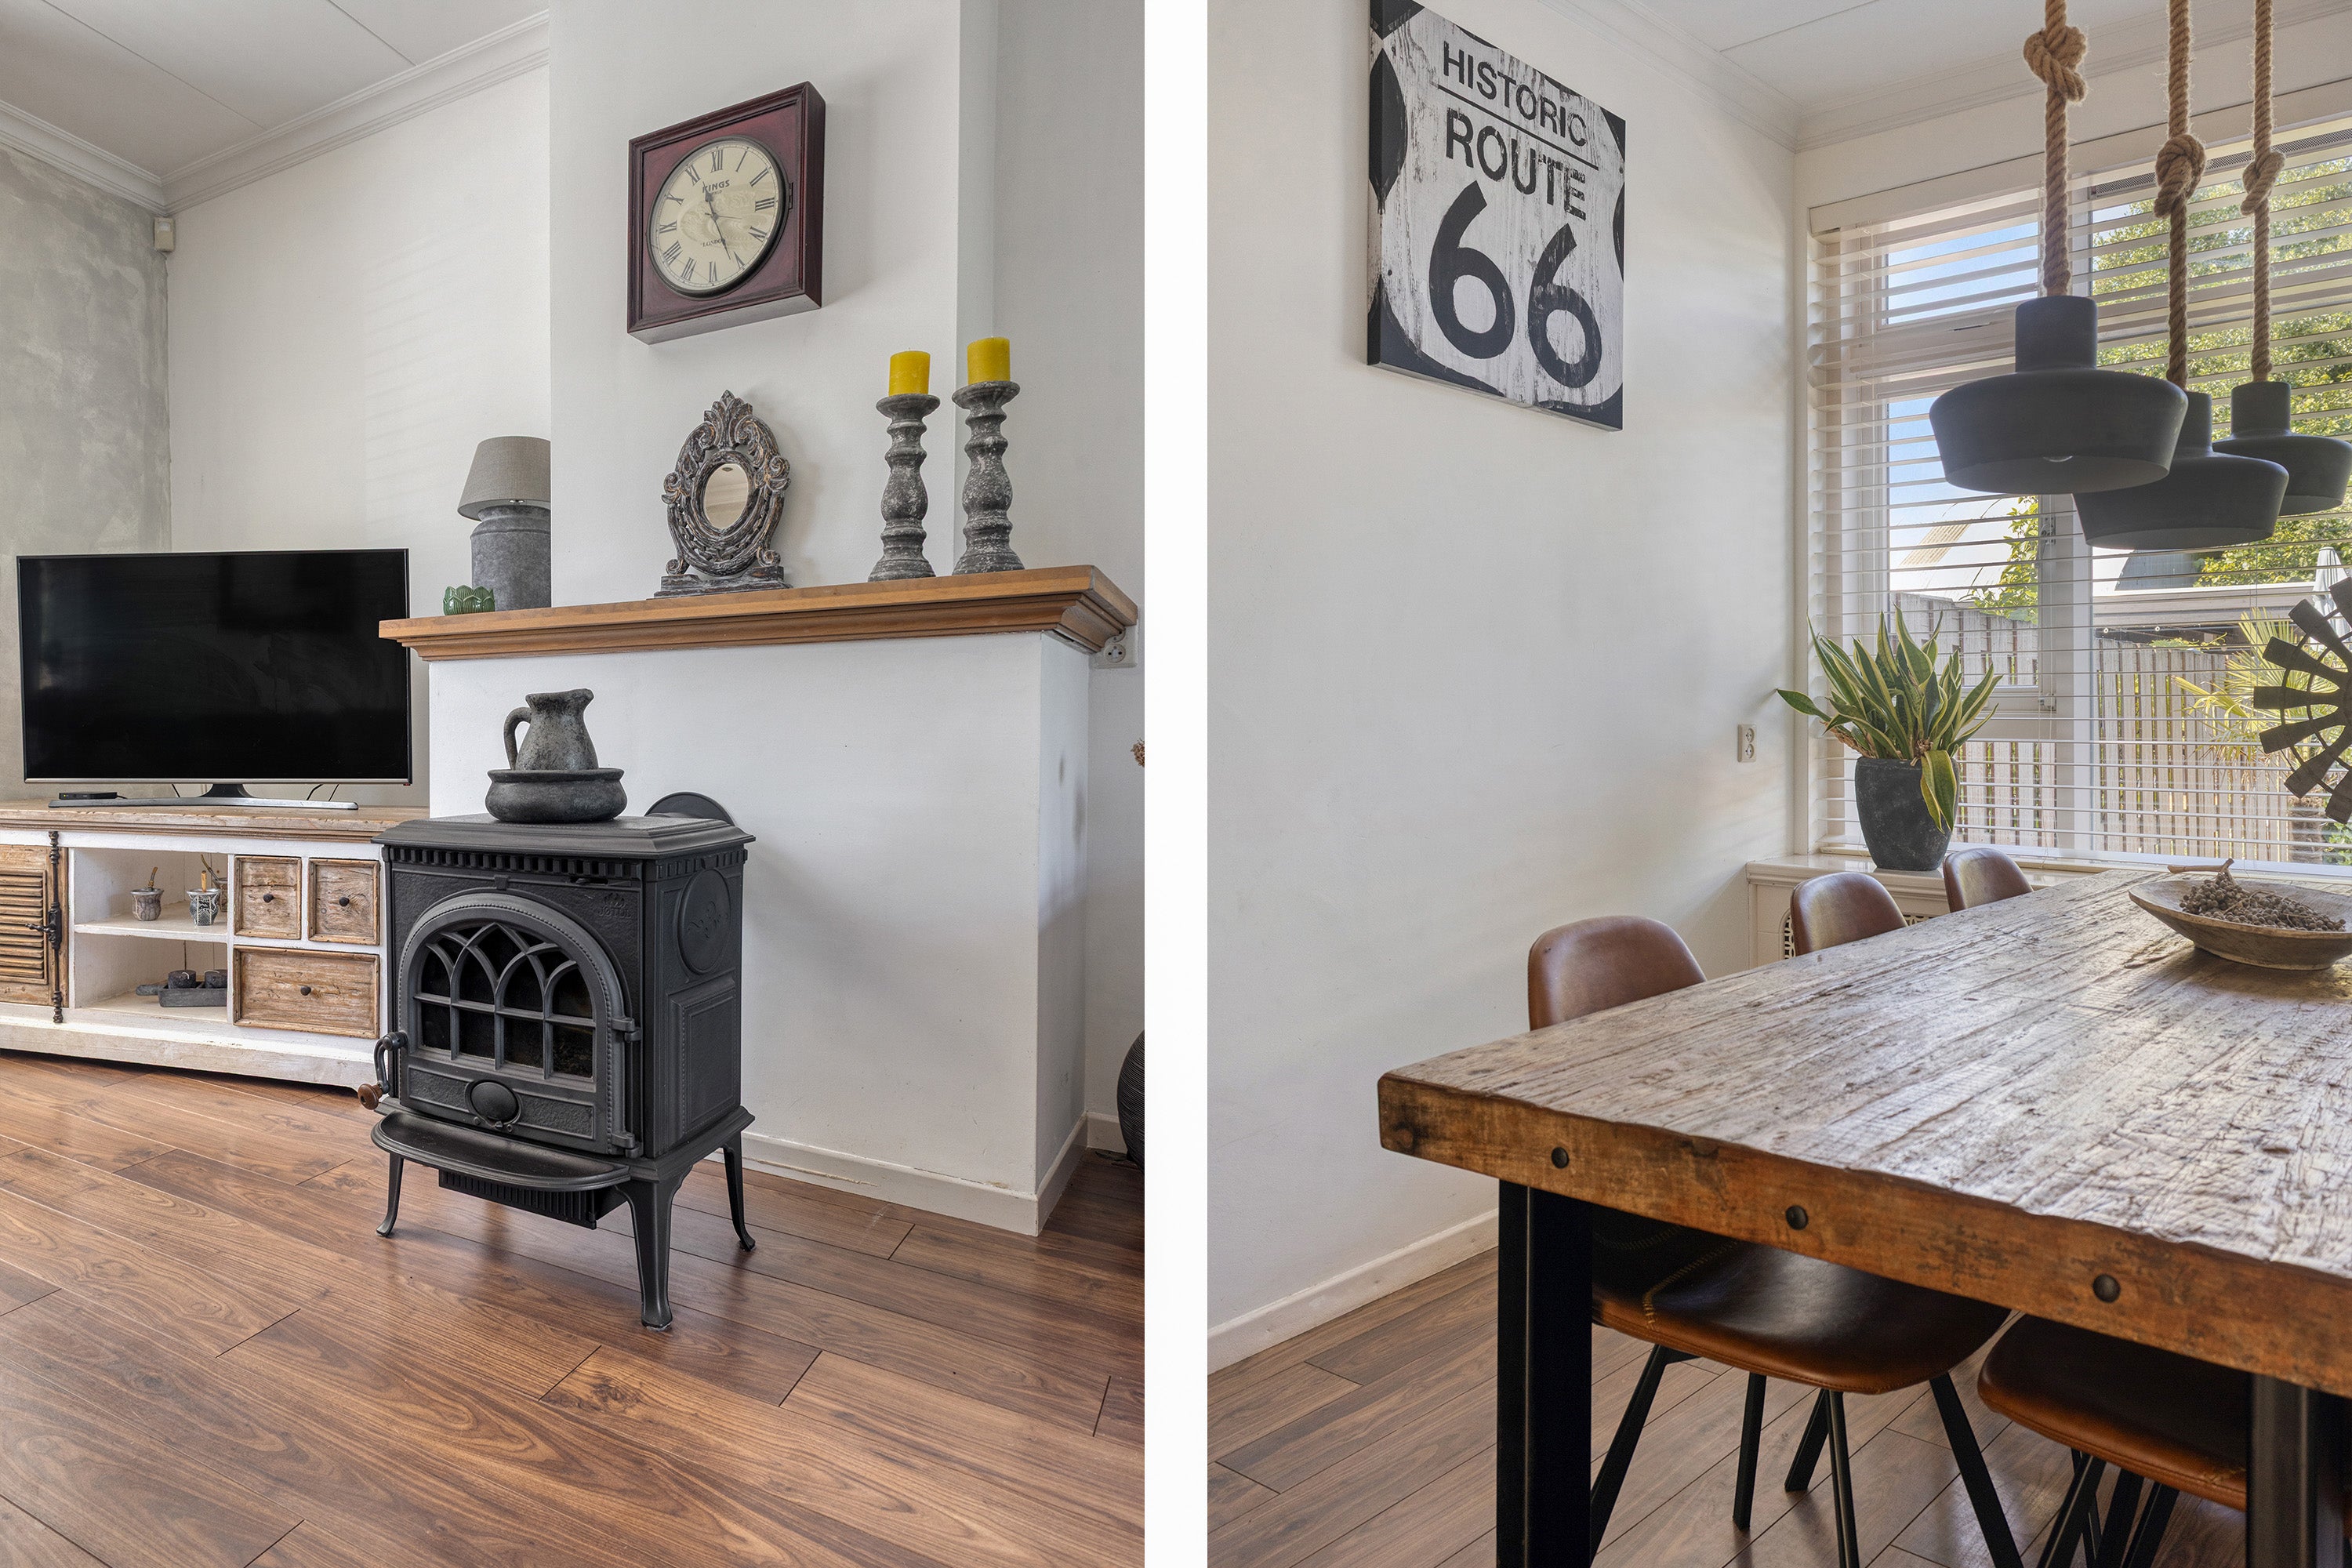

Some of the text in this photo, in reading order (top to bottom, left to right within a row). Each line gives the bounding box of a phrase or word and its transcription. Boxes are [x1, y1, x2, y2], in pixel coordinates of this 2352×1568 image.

[1443, 40, 1588, 147] HISTORIC
[710, 149, 724, 173] XII
[1446, 107, 1587, 221] ROUTE
[684, 163, 701, 186] XI
[702, 180, 730, 194] KINGS
[702, 238, 726, 248] LONDO
[1428, 180, 1602, 389] 66
